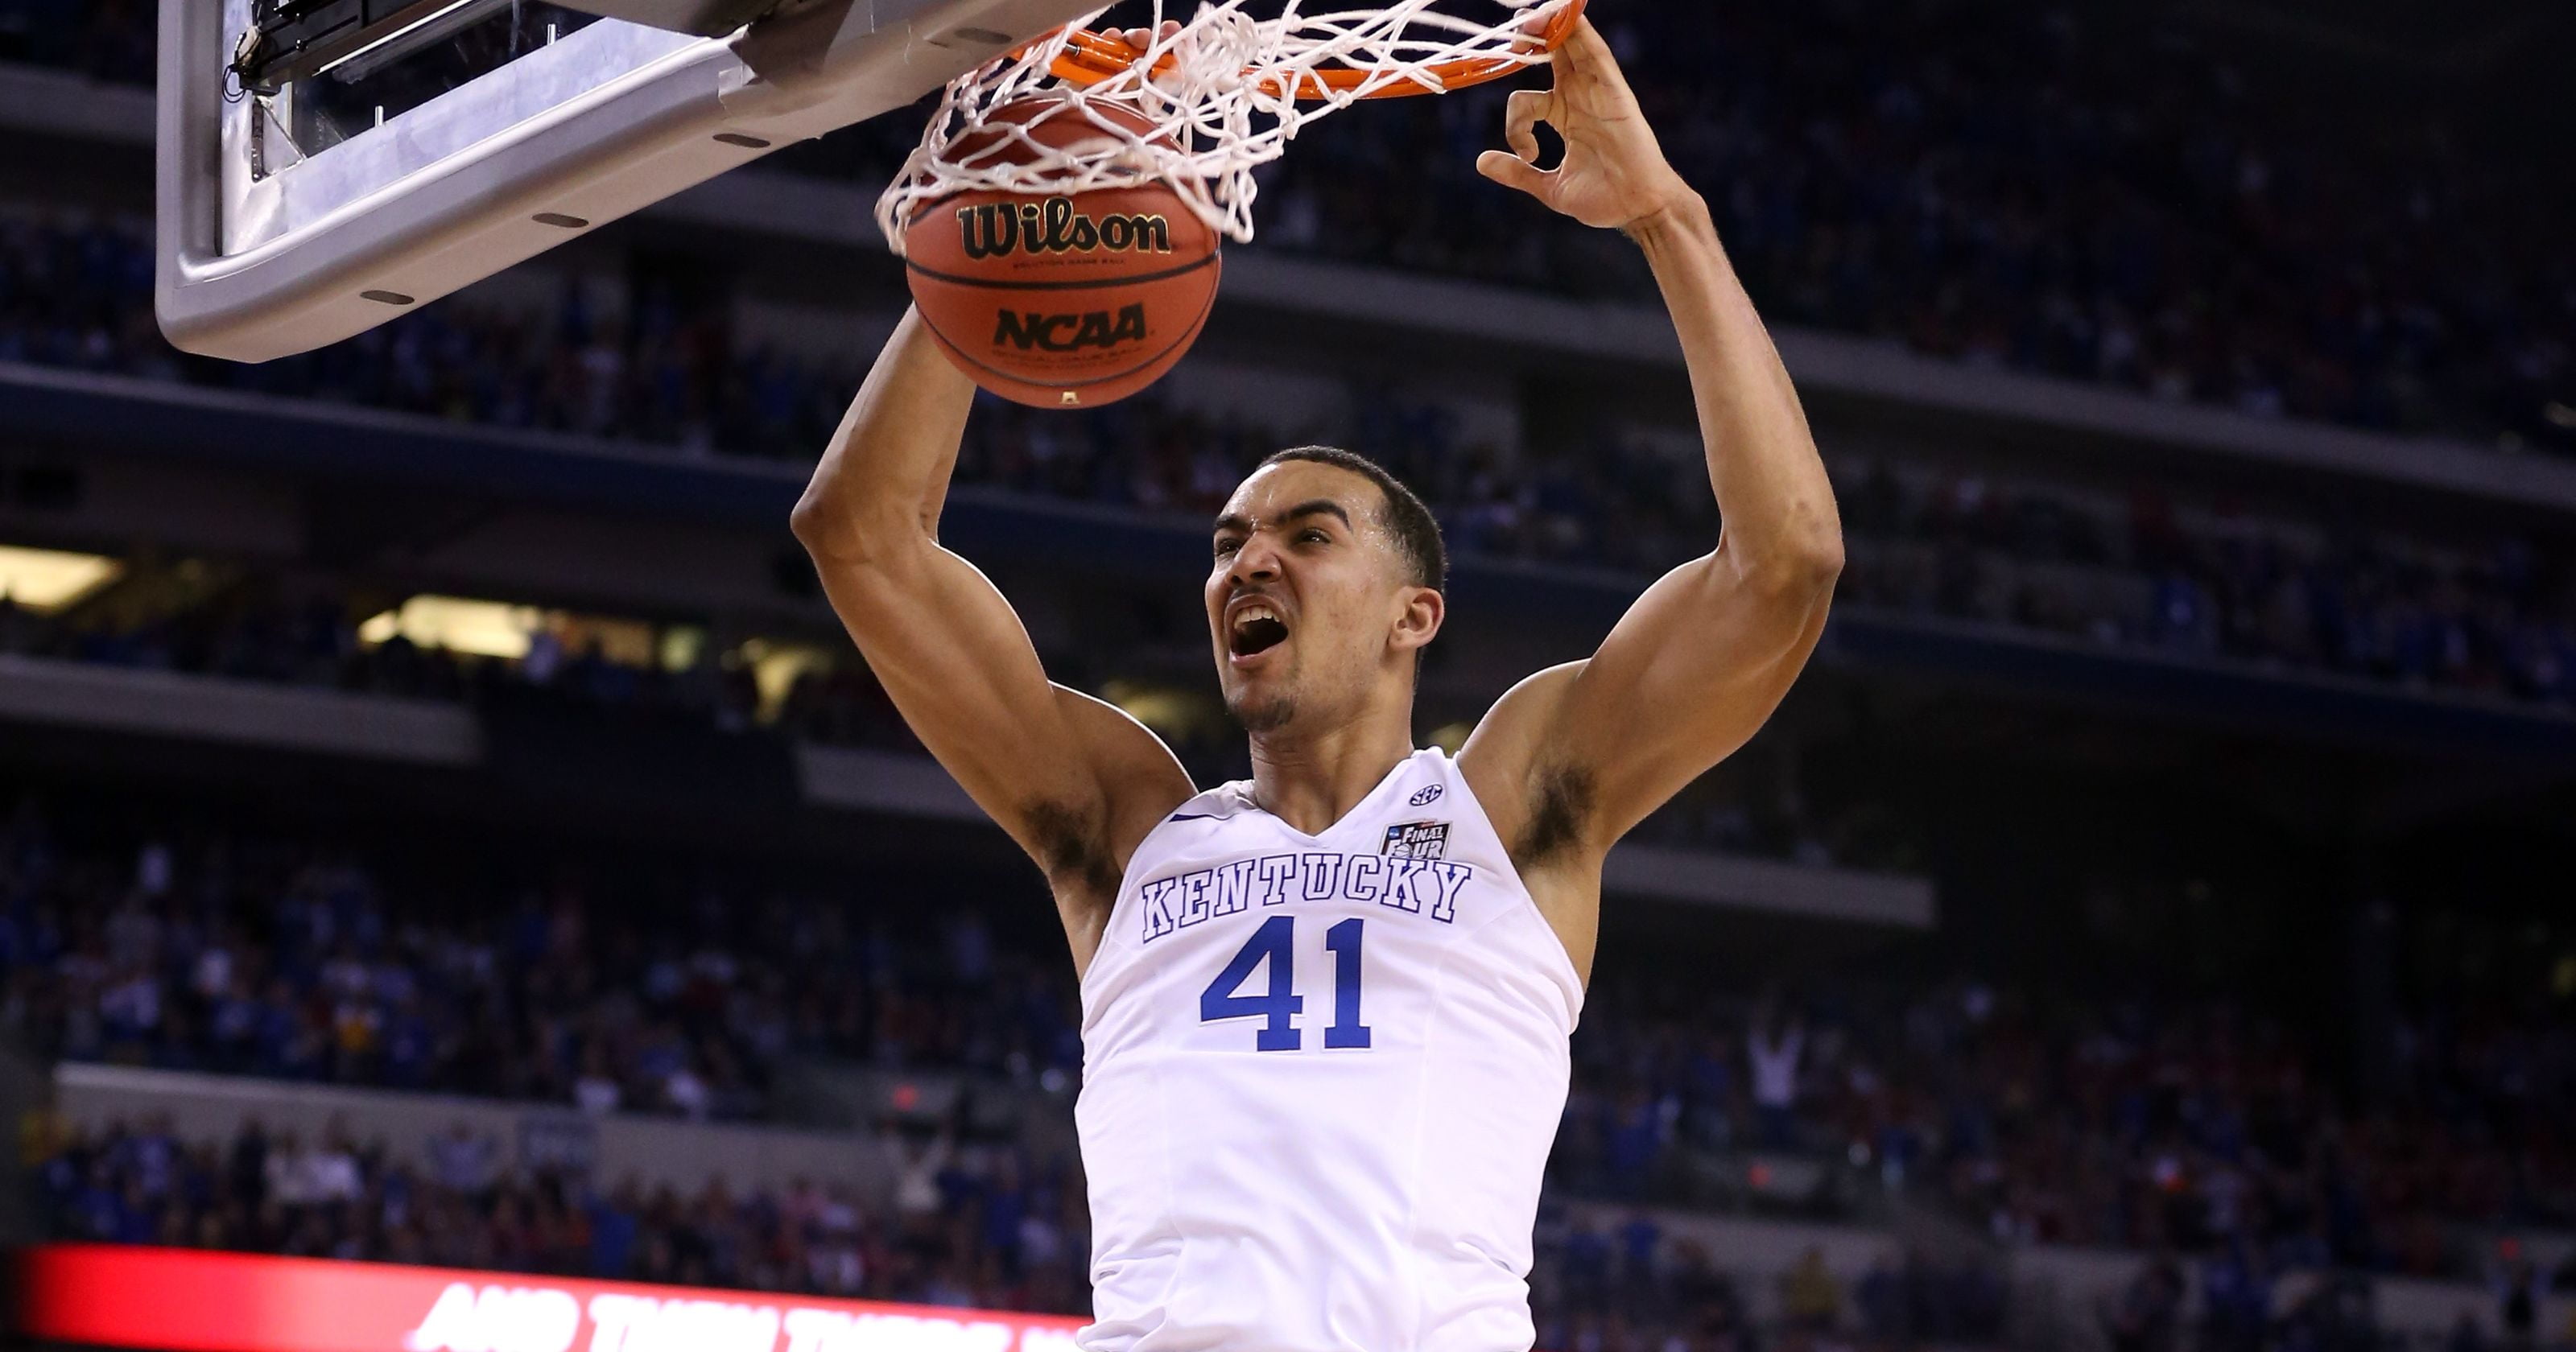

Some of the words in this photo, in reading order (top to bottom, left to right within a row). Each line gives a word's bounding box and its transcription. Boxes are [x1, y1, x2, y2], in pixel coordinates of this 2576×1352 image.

[956, 196, 1171, 260] Wilson
[993, 302, 1146, 352] NCAA
[1410, 784, 1443, 806] SEC
[1385, 839, 1443, 859] FOUR
[1402, 826, 1443, 843] FINAL
[1141, 852, 1472, 944] KENTUCKY
[1199, 915, 1372, 1052] 41
